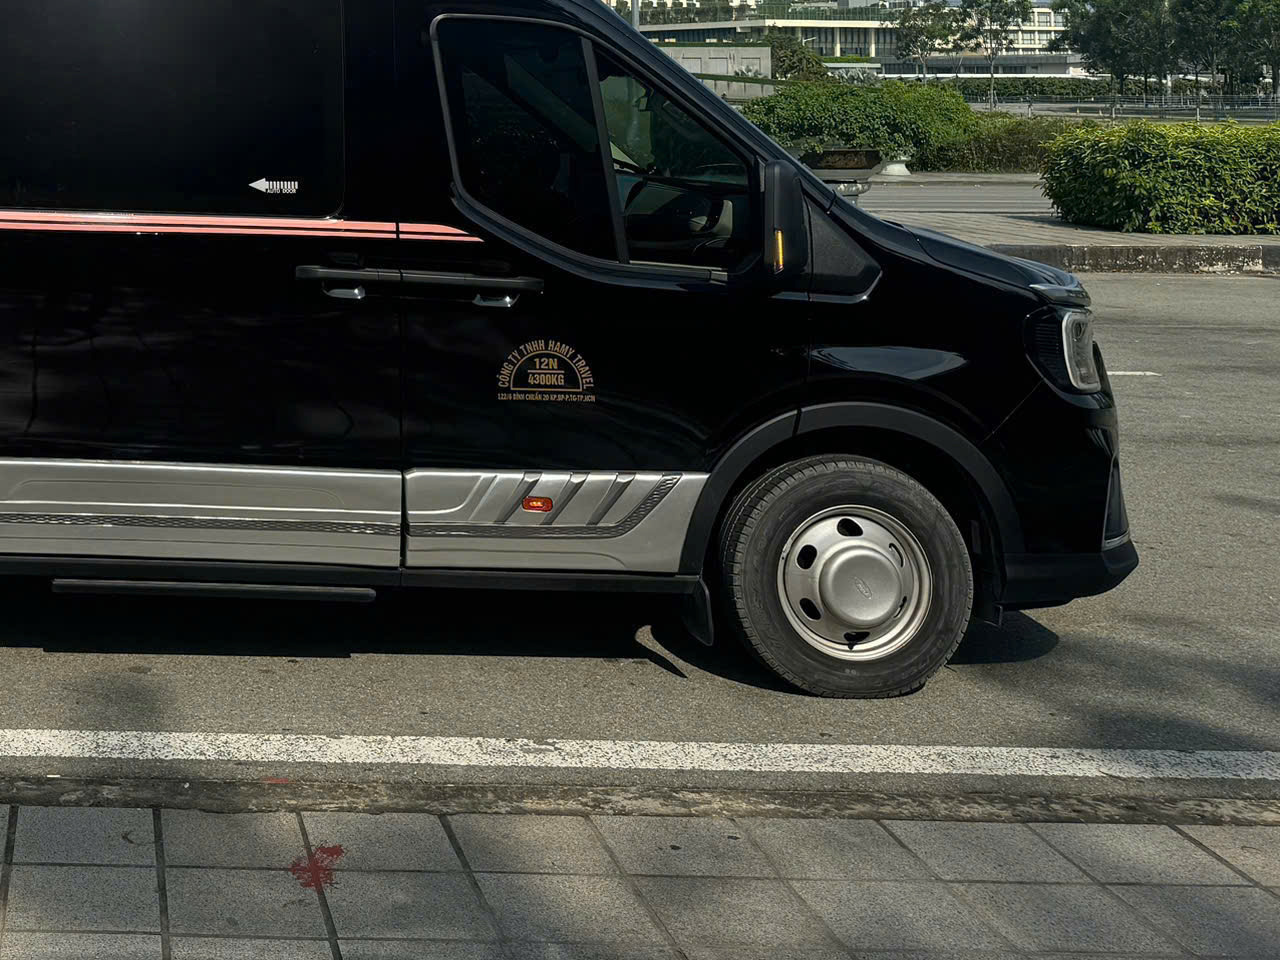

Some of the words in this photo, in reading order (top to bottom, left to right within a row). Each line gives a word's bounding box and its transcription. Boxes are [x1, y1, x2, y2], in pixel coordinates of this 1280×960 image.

[508, 350, 521, 363] TY
[519, 339, 545, 354] TNHH
[548, 339, 575, 357] HAMY
[573, 354, 594, 389] TRAVEL
[534, 358, 558, 369] 12N
[528, 374, 565, 386] 4300KG
